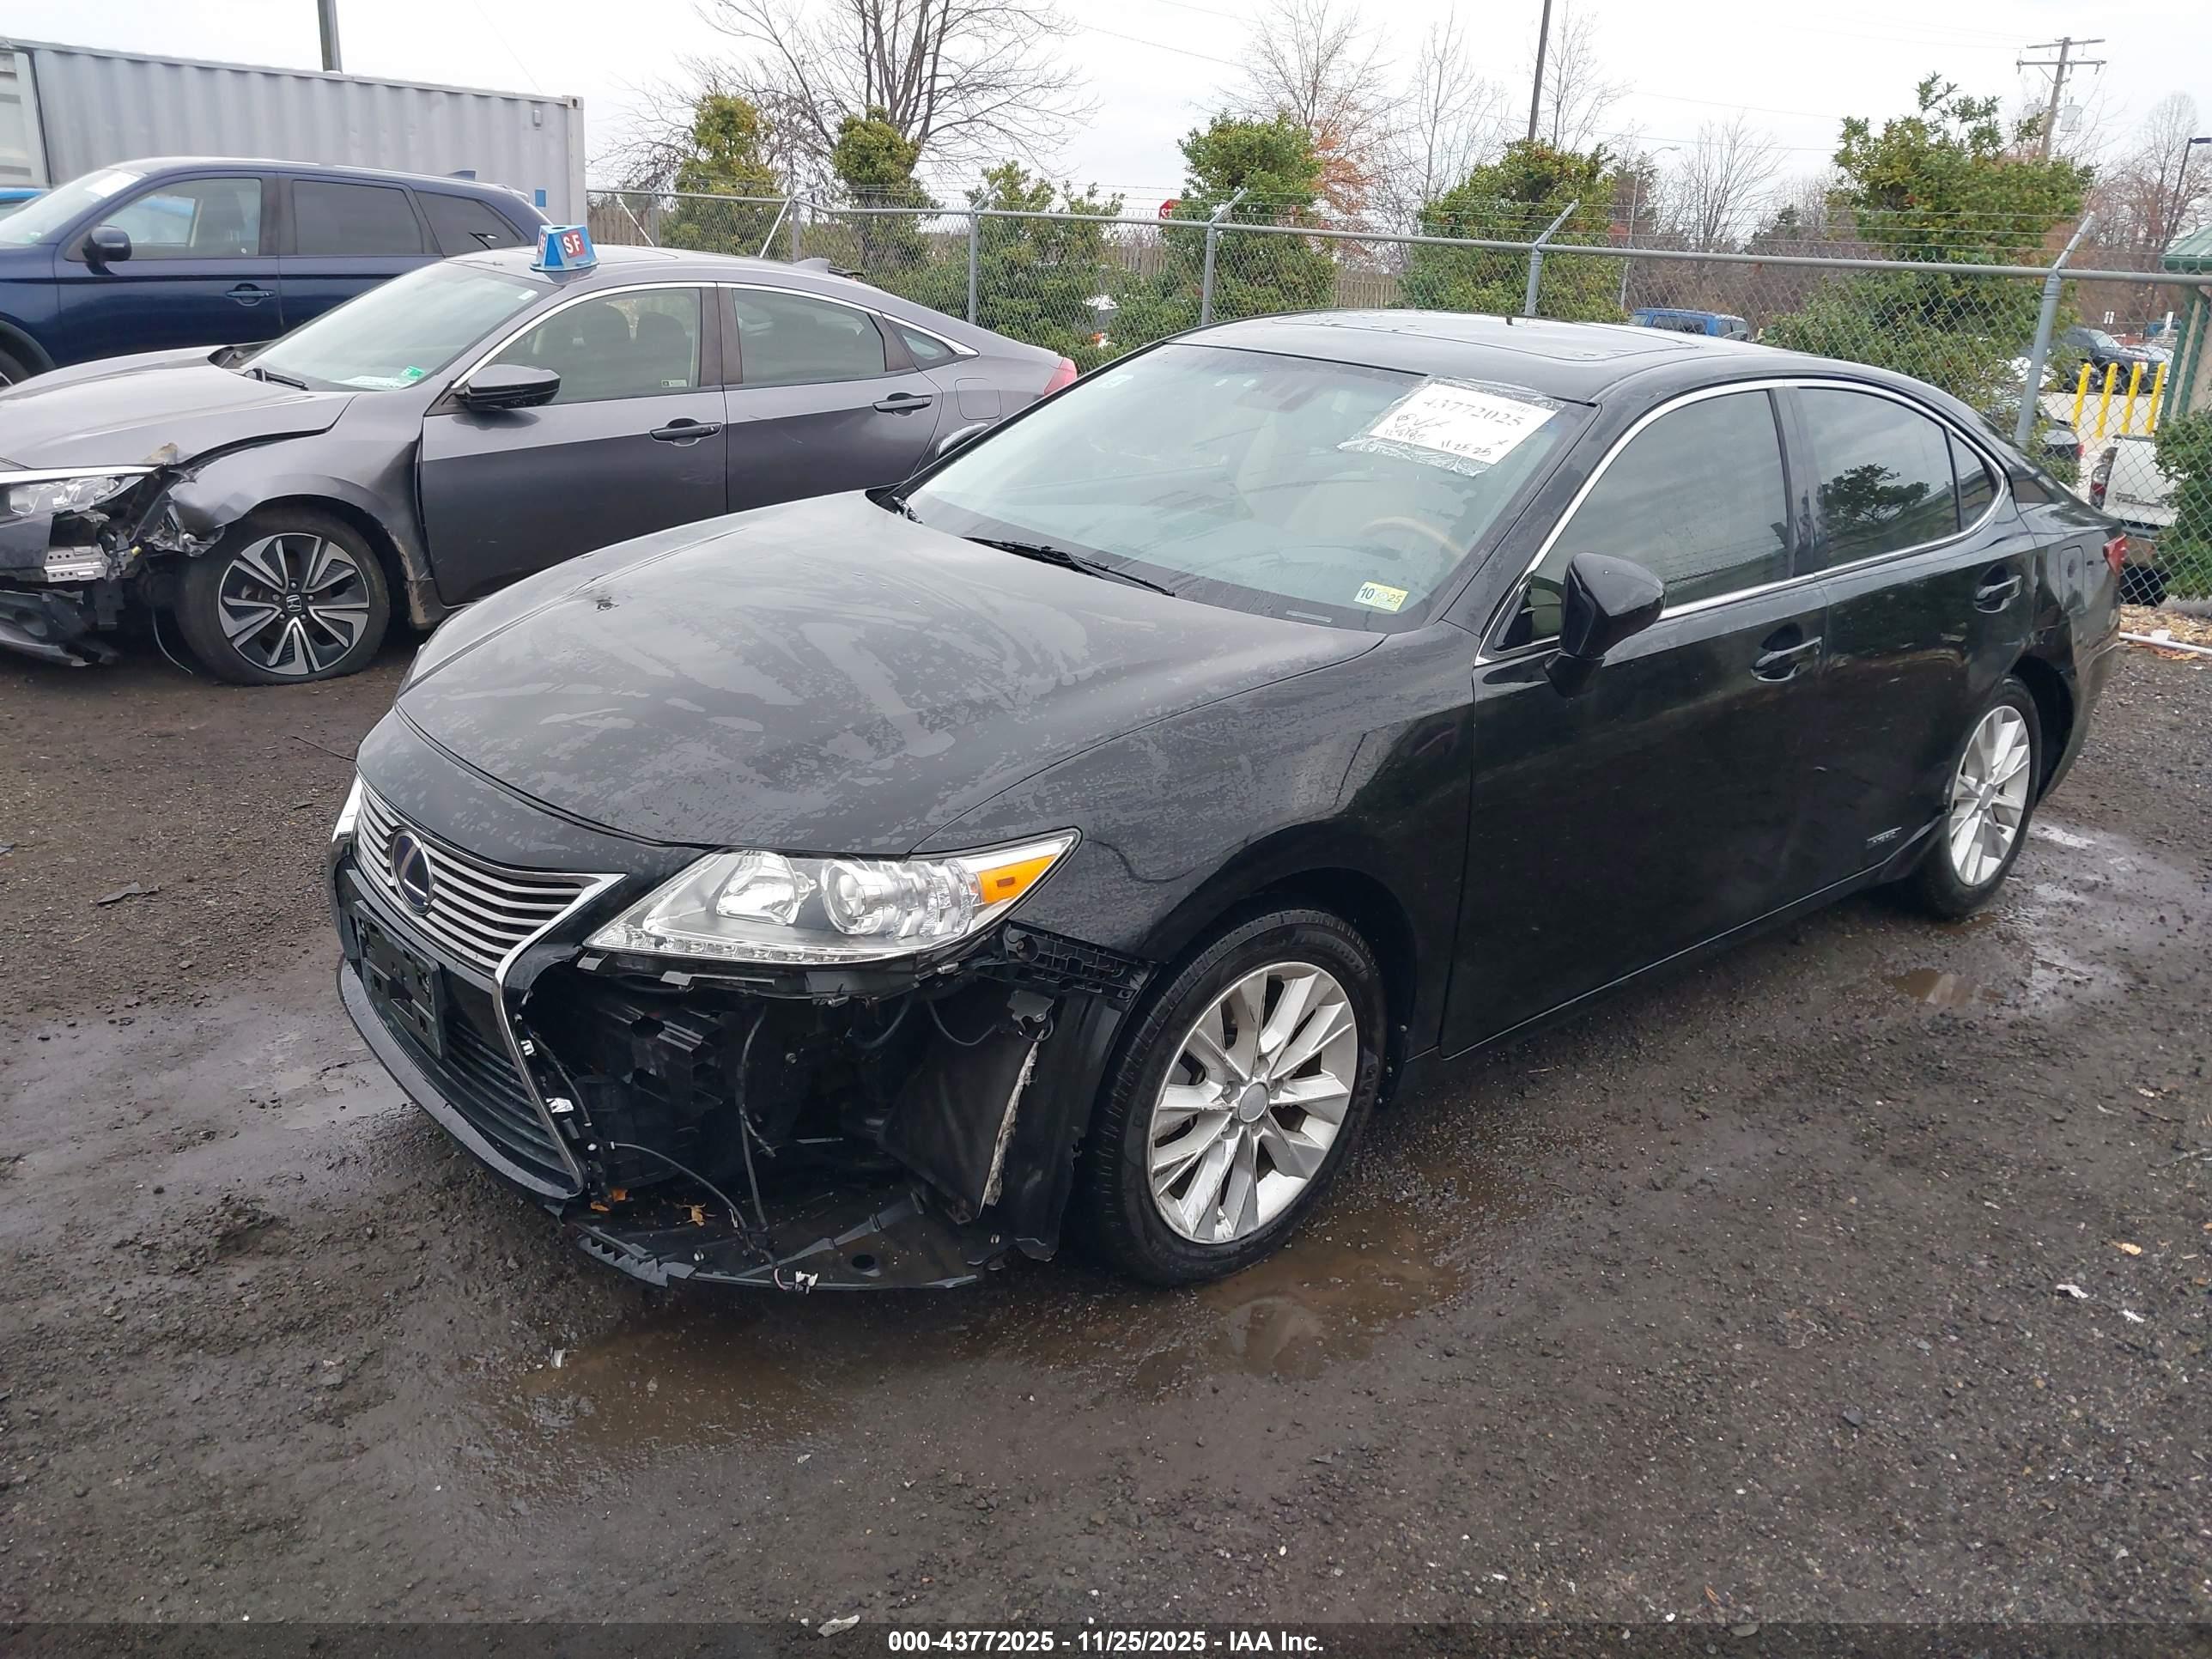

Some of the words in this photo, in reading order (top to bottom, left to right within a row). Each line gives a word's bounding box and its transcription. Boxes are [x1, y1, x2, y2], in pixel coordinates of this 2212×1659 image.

[562, 234, 581, 254] SF
[1423, 398, 1526, 426] 43772025
[1360, 586, 1375, 599] 10
[1388, 593, 1403, 604] 25
